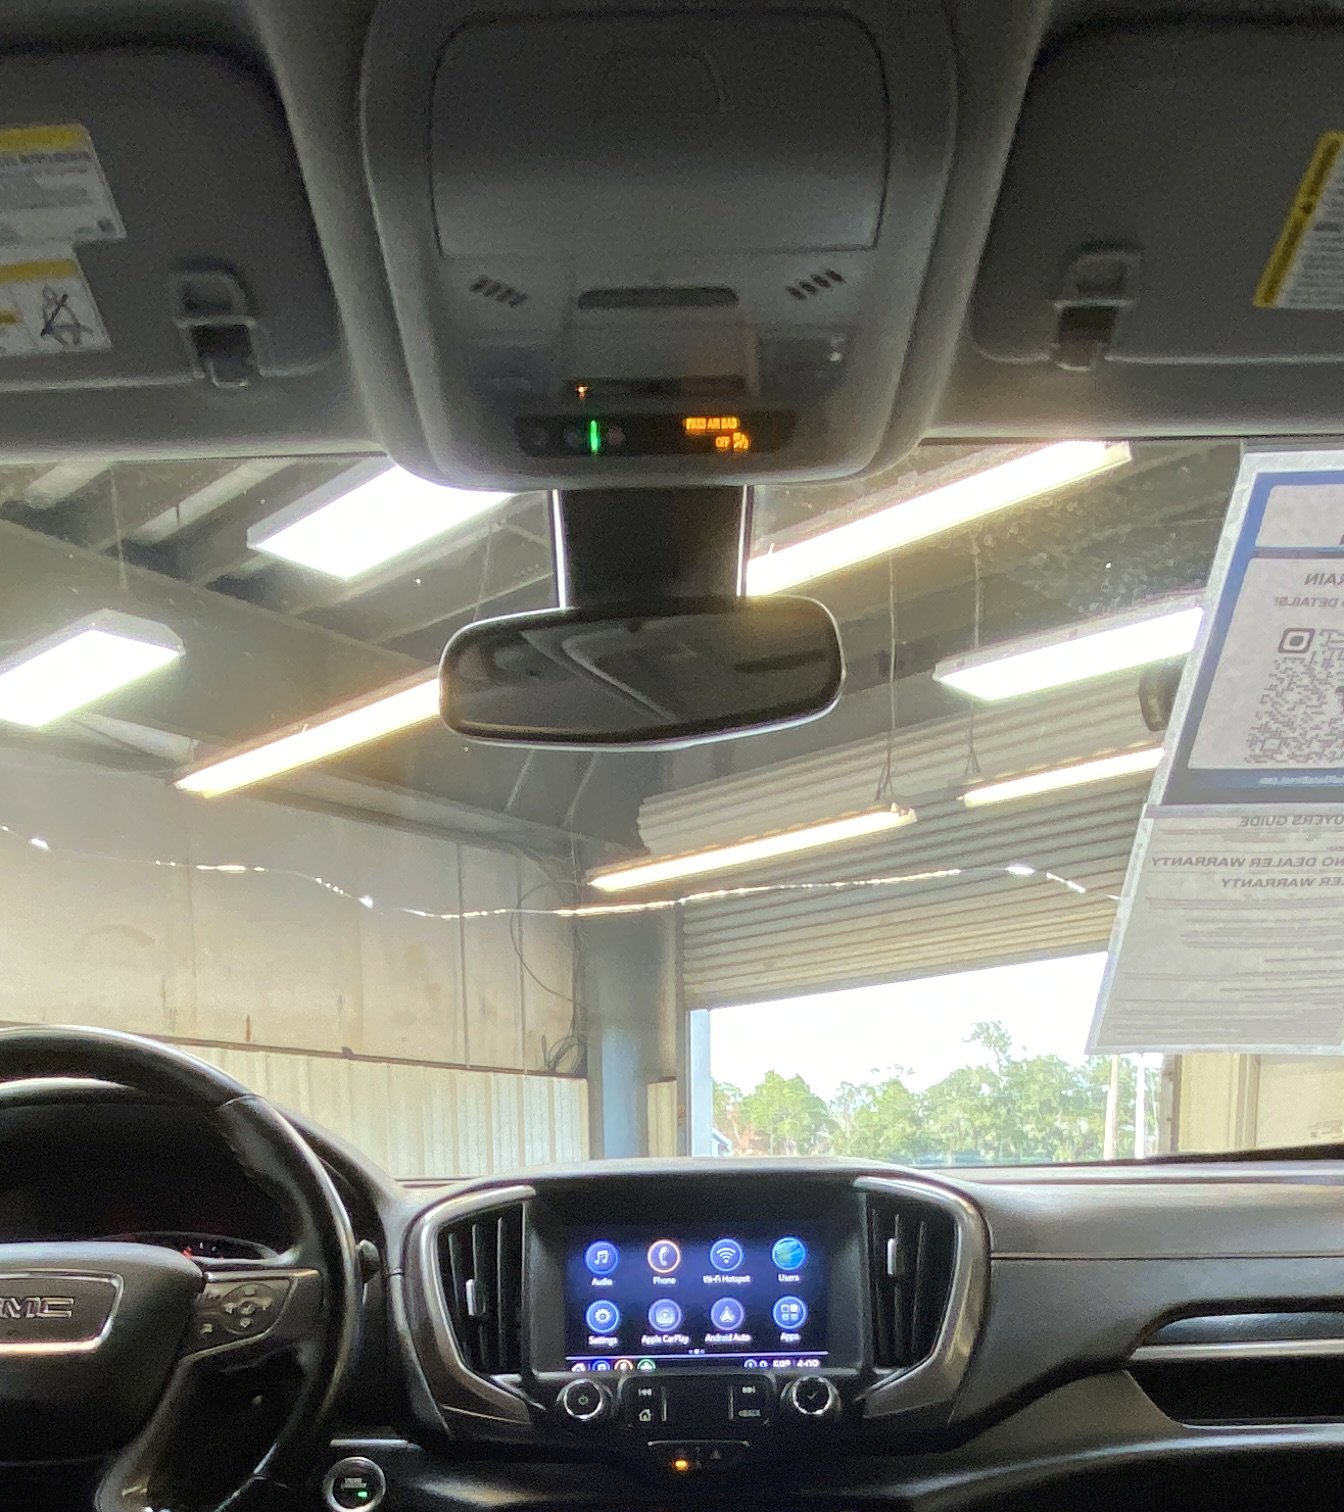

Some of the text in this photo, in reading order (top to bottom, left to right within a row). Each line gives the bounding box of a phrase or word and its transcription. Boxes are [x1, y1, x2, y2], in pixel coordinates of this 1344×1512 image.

[591, 1277, 614, 1287] Audio
[652, 1275, 677, 1286] Phone
[722, 1274, 752, 1286] Hotspot
[777, 1272, 801, 1283] Users
[587, 1335, 619, 1346] Settings
[640, 1334, 690, 1346] Apple CarPlay
[704, 1333, 752, 1343] Android Auto
[779, 1332, 801, 1344] Apps
